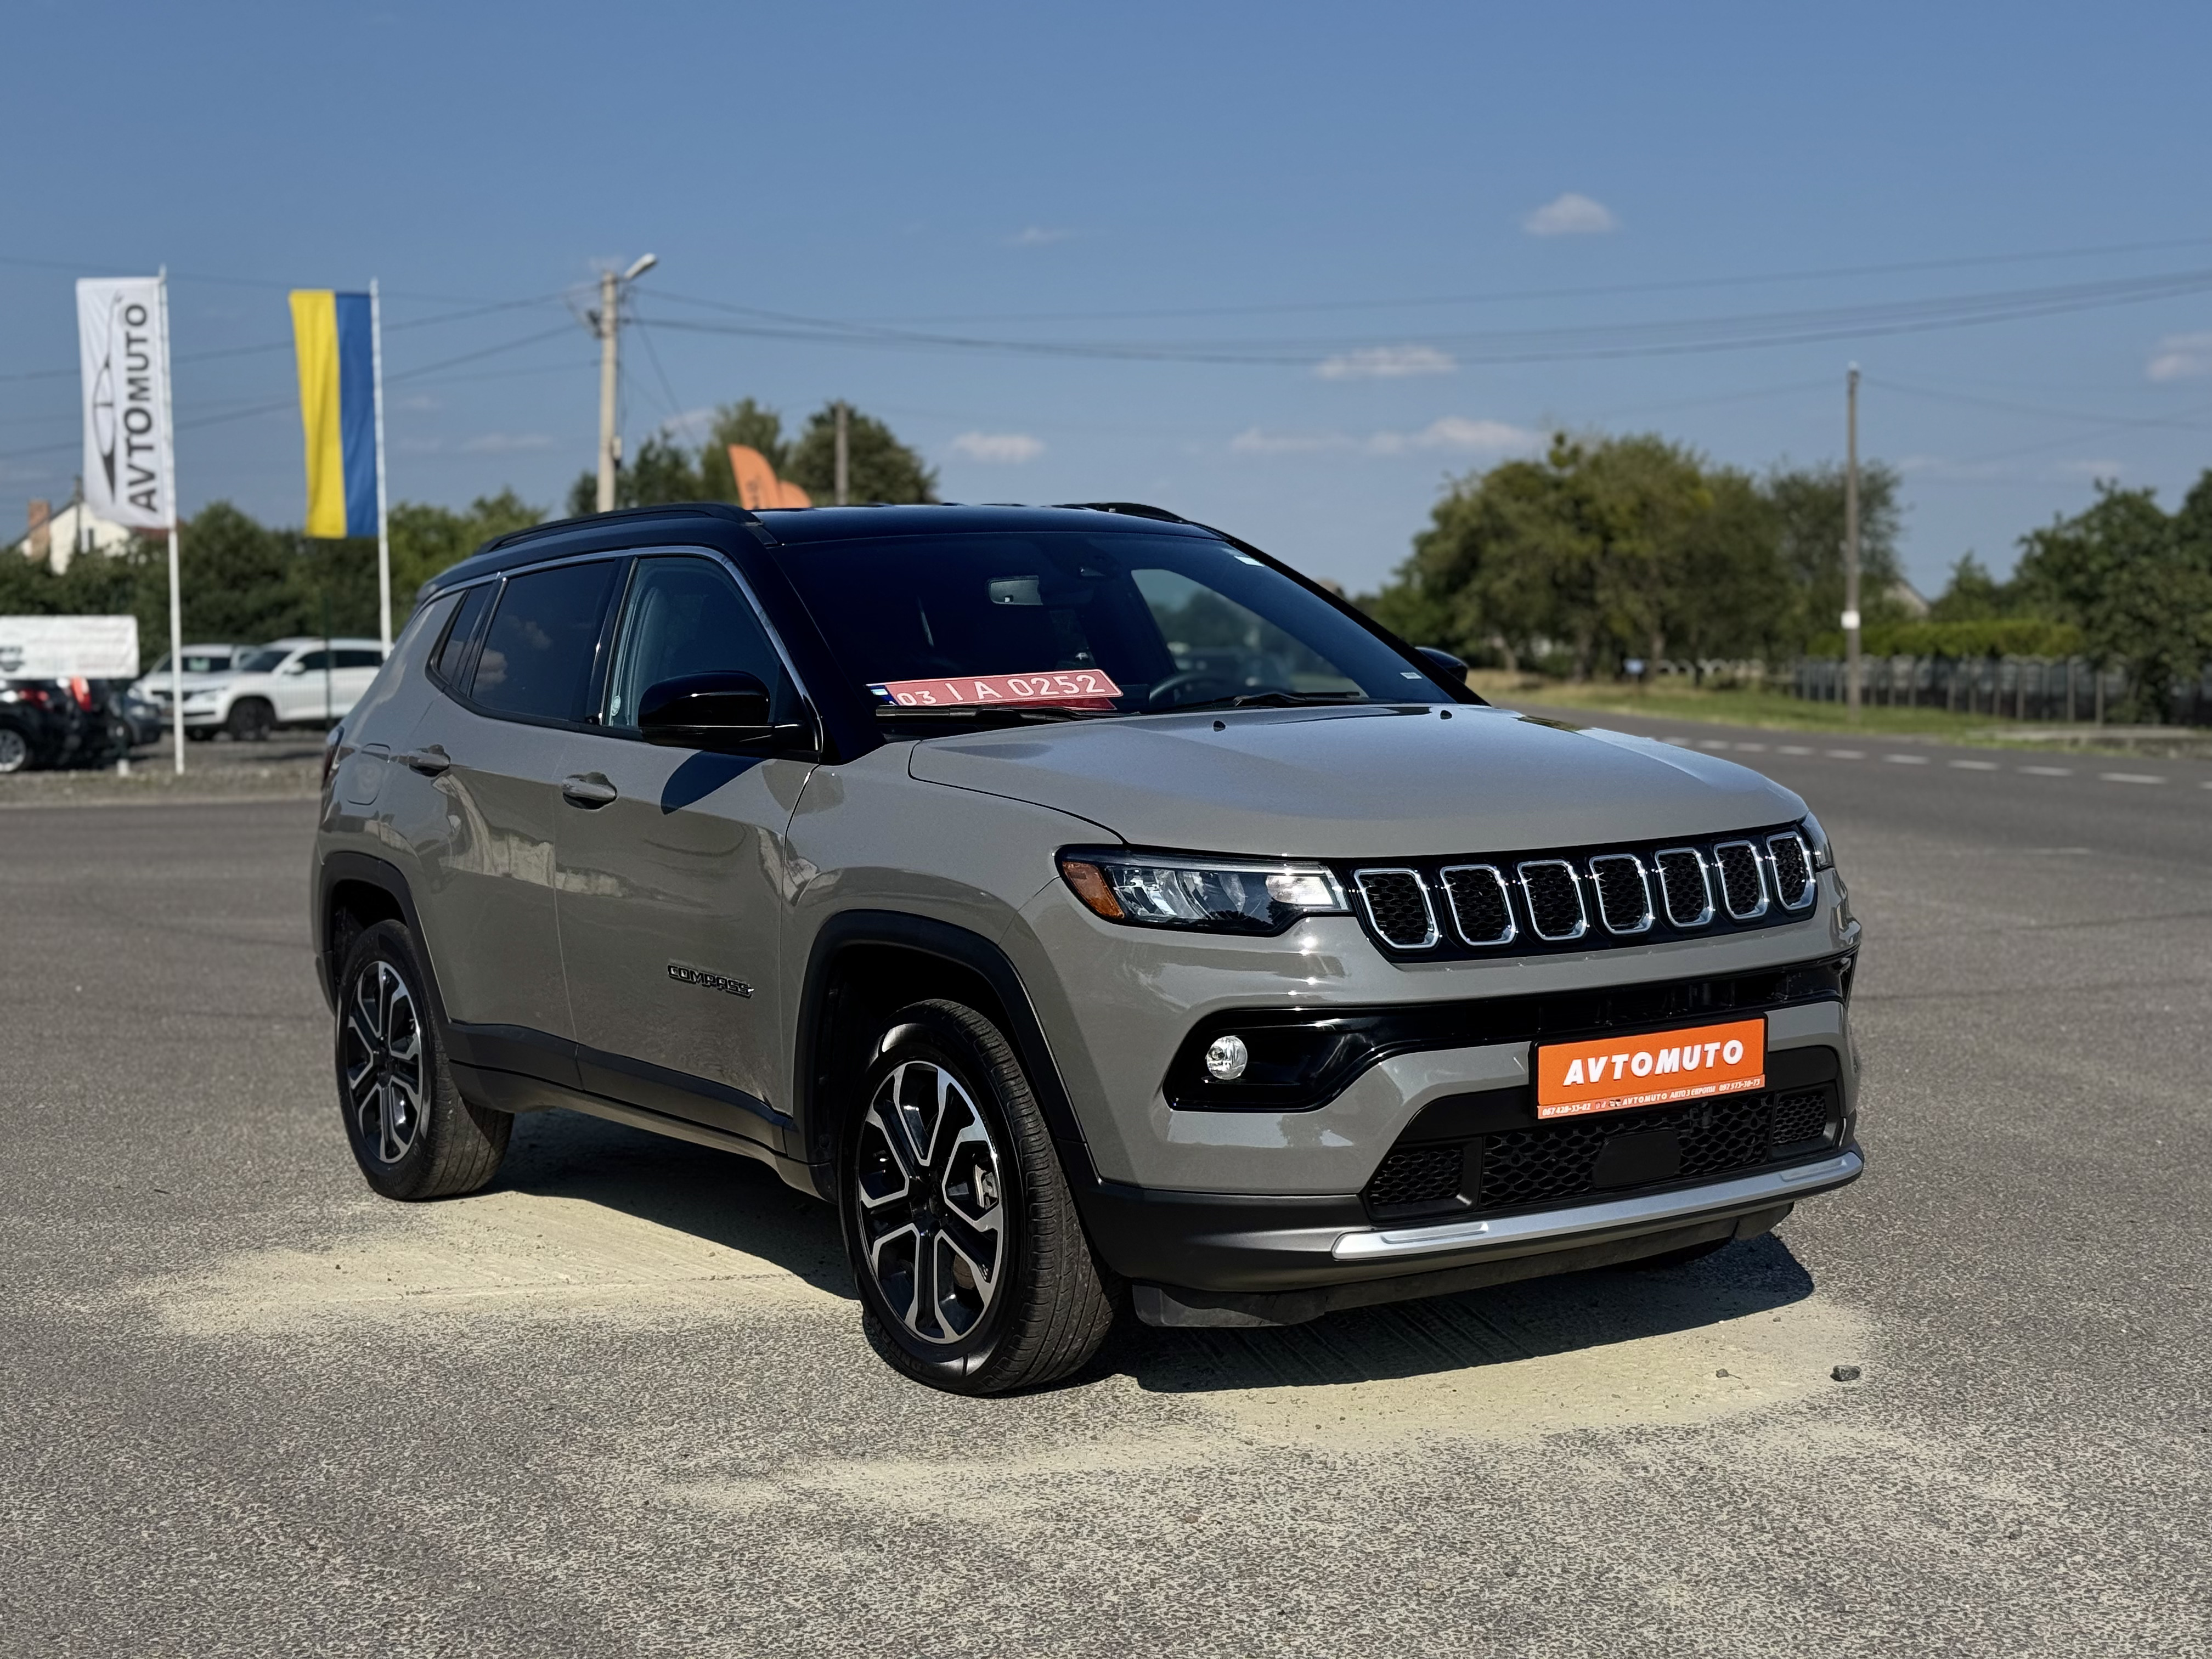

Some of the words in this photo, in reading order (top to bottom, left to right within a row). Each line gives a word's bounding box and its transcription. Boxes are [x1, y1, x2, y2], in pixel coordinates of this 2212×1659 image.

[123, 303, 158, 514] AVTOMUTO
[896, 690, 937, 706] 03
[1007, 674, 1106, 697] 0252
[667, 964, 753, 998] COMPASS
[1562, 1039, 1745, 1087] AVTOMUTO
[1622, 1092, 1668, 1107] AVTOMUTO
